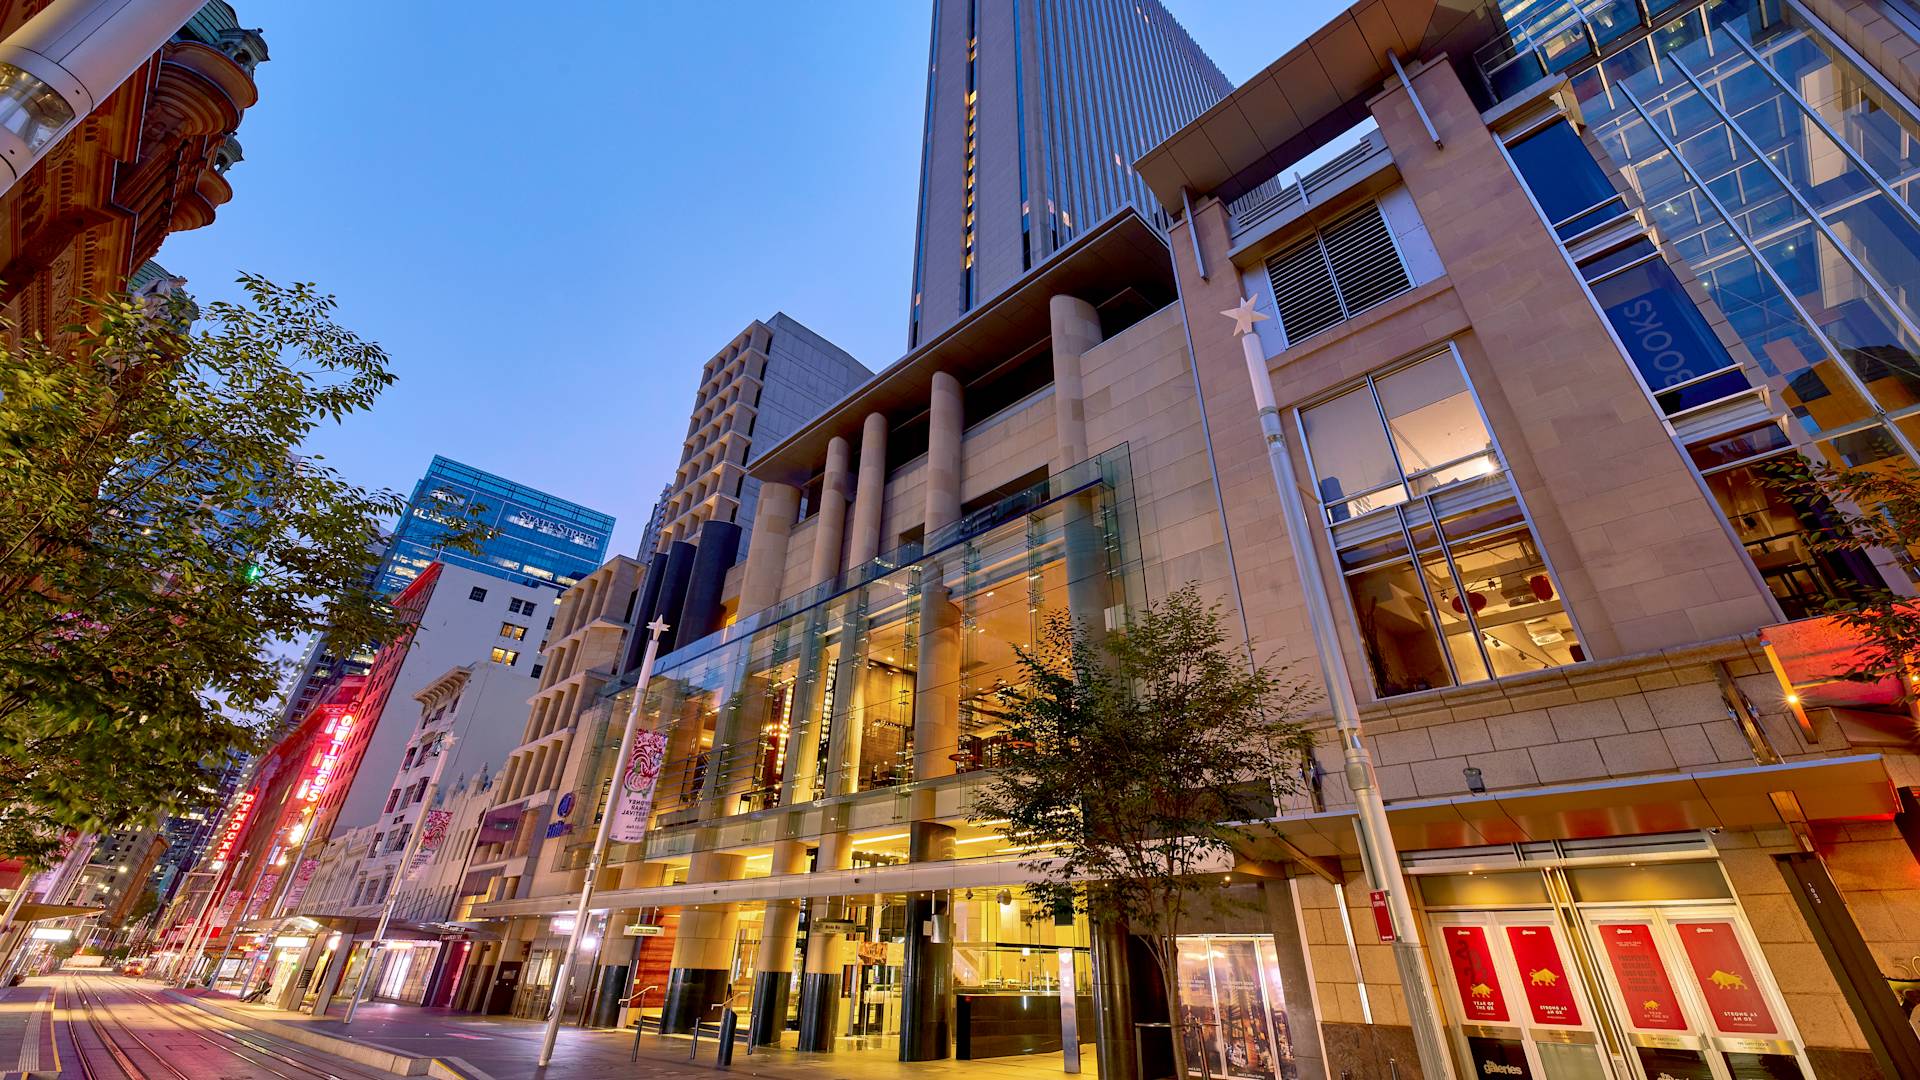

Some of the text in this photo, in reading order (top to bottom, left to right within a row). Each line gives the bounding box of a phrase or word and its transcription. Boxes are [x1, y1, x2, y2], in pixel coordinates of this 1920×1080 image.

[519, 510, 599, 545] STATE STREET
[306, 701, 359, 802] GOWINGS
[217, 794, 255, 859] DYMOCKS
[1483, 1063, 1522, 1075] galeries
